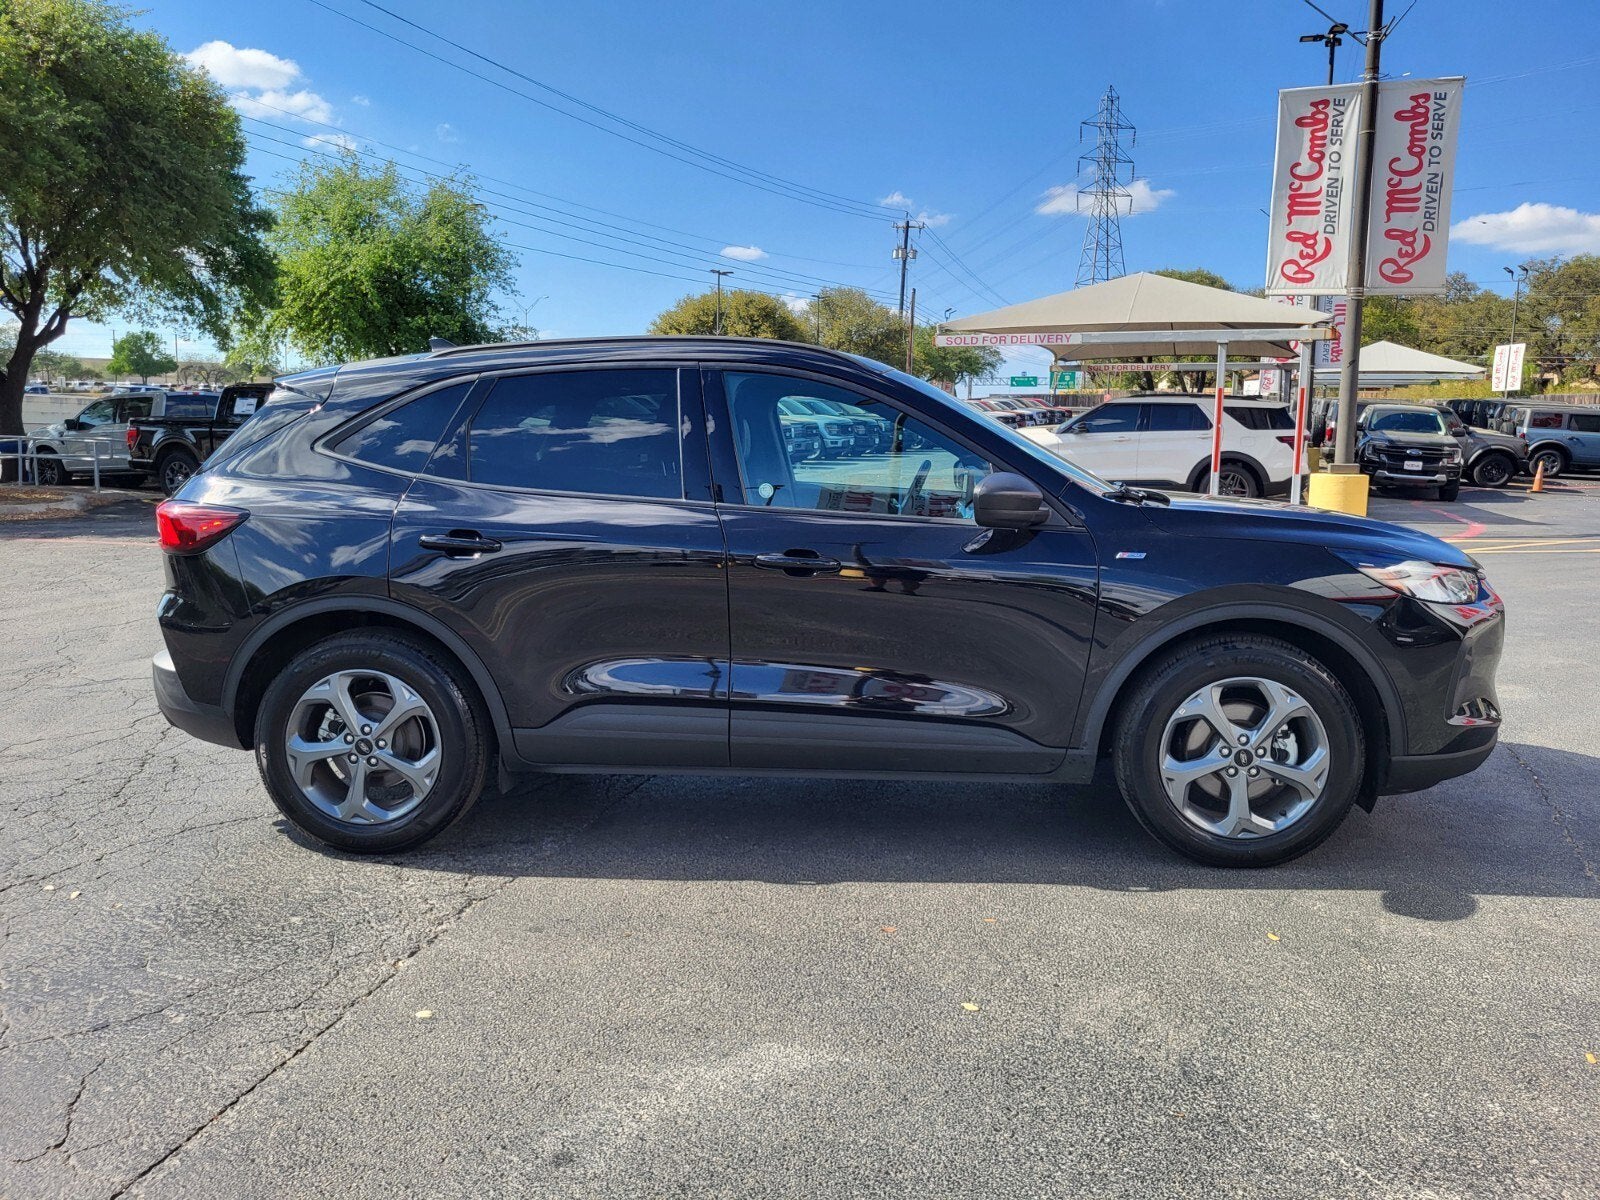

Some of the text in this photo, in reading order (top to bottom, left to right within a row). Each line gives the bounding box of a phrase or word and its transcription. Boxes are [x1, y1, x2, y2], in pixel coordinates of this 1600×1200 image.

[1281, 98, 1332, 284] Red McCombs
[1324, 97, 1346, 235] DRIVEN TO SERVE
[1379, 92, 1431, 284] Red McCombs
[1422, 91, 1447, 232] DRIVEN TO SERVE
[945, 334, 1072, 346] SOLD FOR DELIVERY
